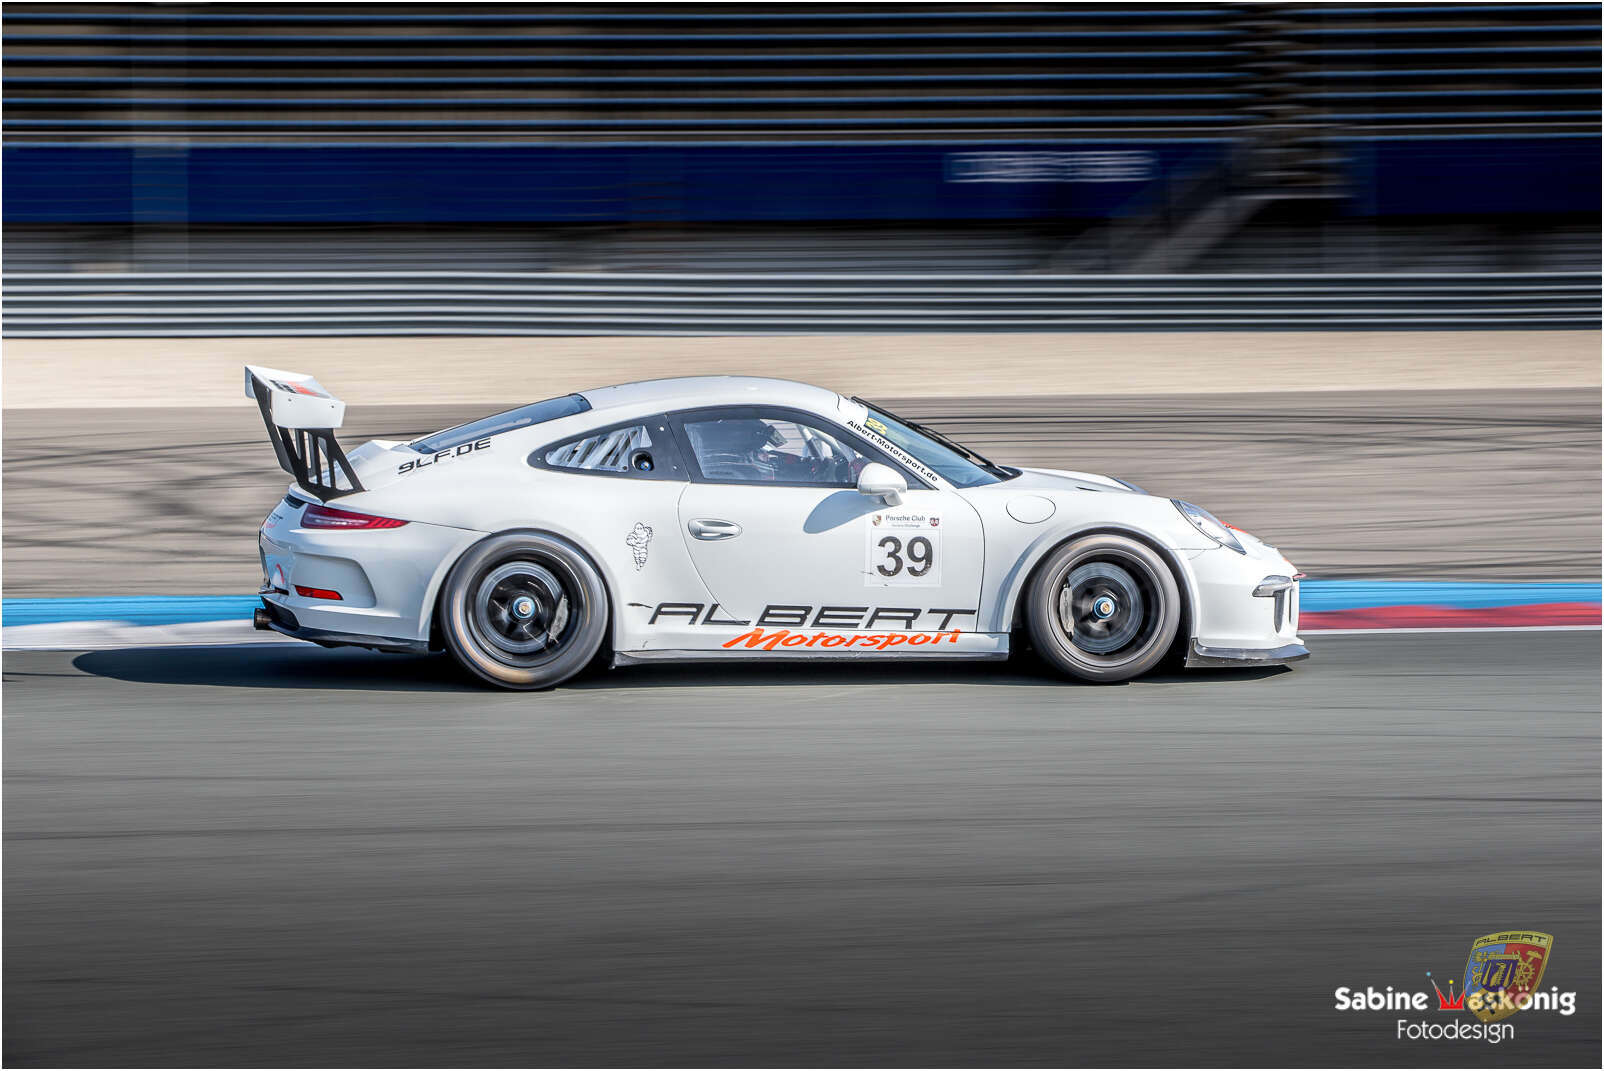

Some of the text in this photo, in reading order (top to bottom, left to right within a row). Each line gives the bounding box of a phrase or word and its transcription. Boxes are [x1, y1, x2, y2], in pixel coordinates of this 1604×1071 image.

[398, 438, 492, 475] 9LF.DE
[847, 420, 938, 482] Albert-Motorsport.de
[877, 536, 933, 577] 39
[648, 602, 977, 631] ALBERT
[721, 627, 962, 651] Motorsport
